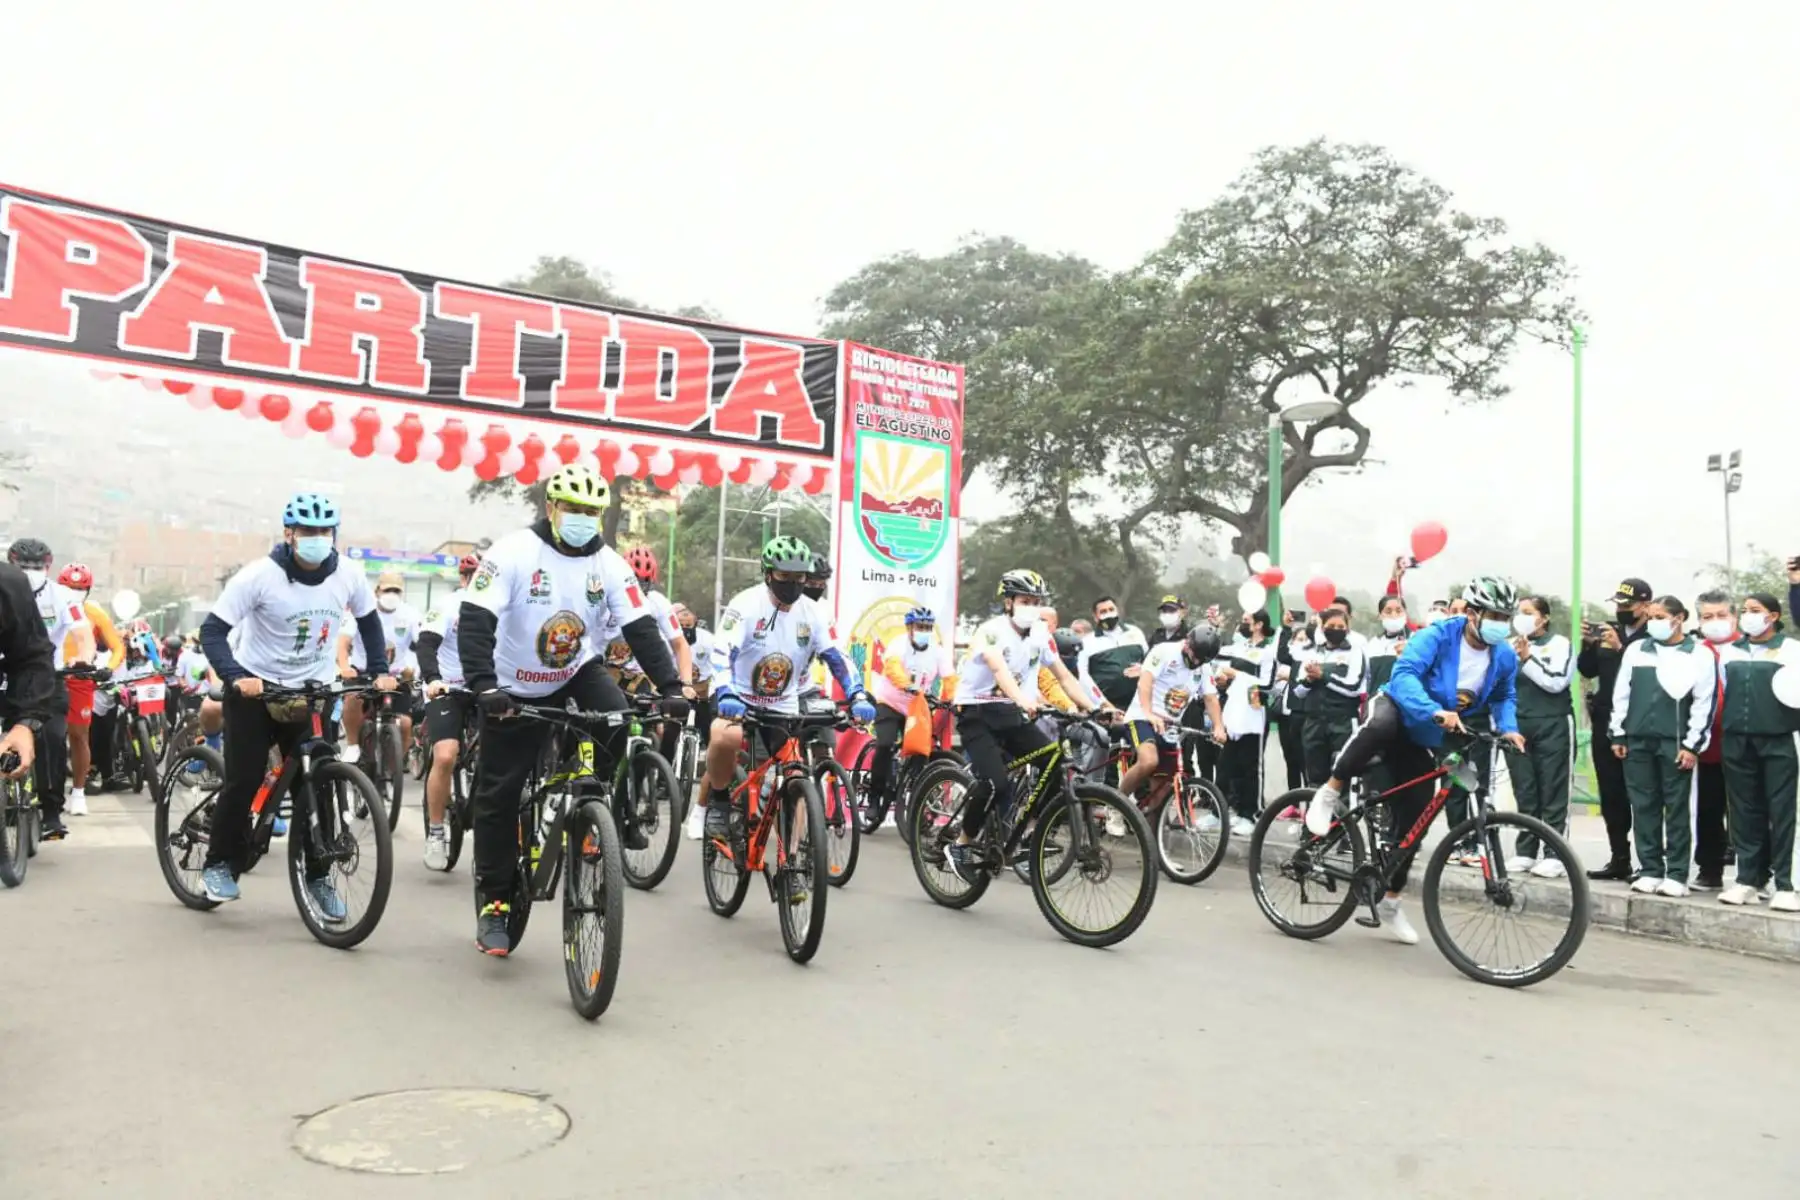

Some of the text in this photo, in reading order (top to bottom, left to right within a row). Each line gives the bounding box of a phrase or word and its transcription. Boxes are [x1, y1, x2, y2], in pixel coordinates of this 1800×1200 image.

[0, 197, 825, 449] PARTIDA
[856, 413, 951, 441] EL AGUSTINO
[862, 568, 895, 583] Lima
[908, 574, 937, 587] Perú
